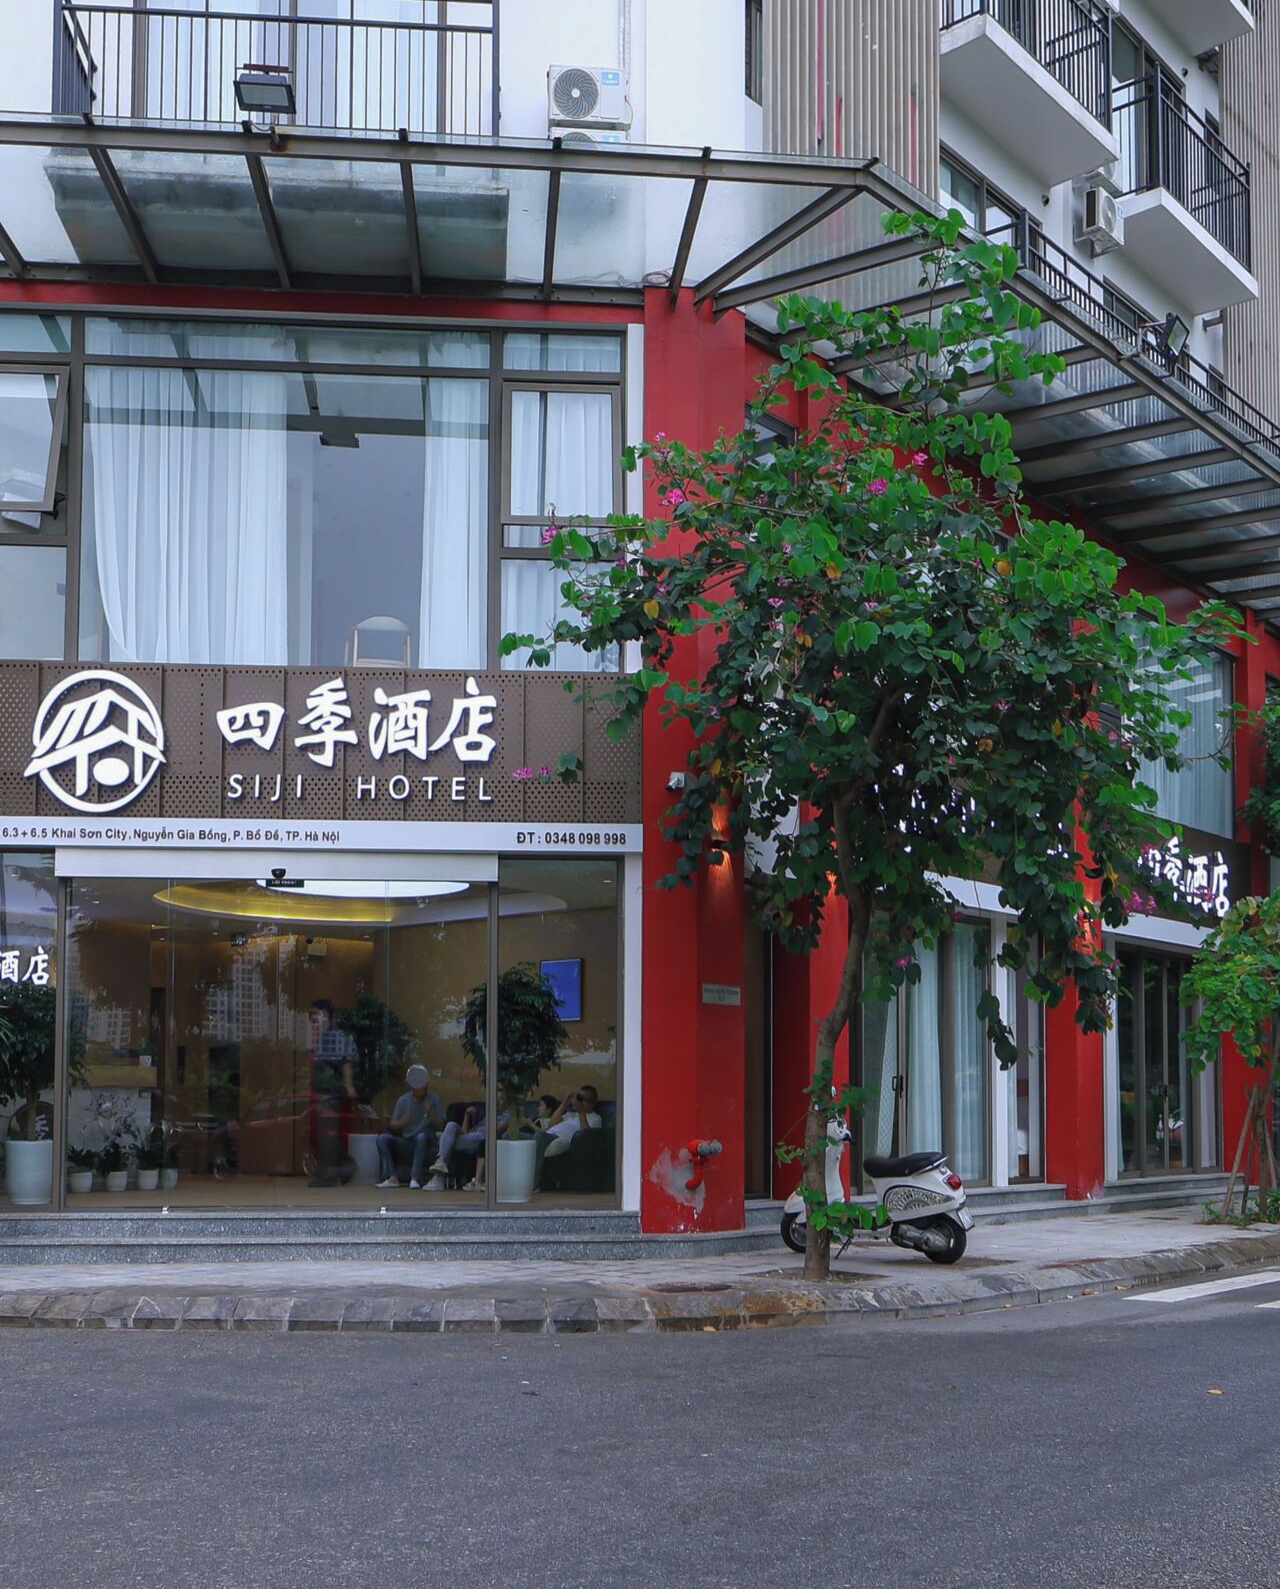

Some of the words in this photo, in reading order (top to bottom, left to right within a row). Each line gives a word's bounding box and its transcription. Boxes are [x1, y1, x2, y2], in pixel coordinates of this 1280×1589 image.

[216, 676, 497, 767] 四季酒店
[227, 773, 303, 801] SIJI
[356, 774, 492, 801] HOTEL
[51, 827, 76, 839] Khai
[79, 828, 103, 839] Sơn
[133, 826, 174, 842] Nguyễn
[177, 829, 195, 840] Gia
[233, 830, 244, 841] P.
[285, 830, 303, 841] TP.
[304, 830, 319, 842] Hà
[322, 831, 340, 845] Nội
[544, 832, 576, 845] 0348
[578, 833, 601, 845] 098
[603, 833, 627, 846] 998
